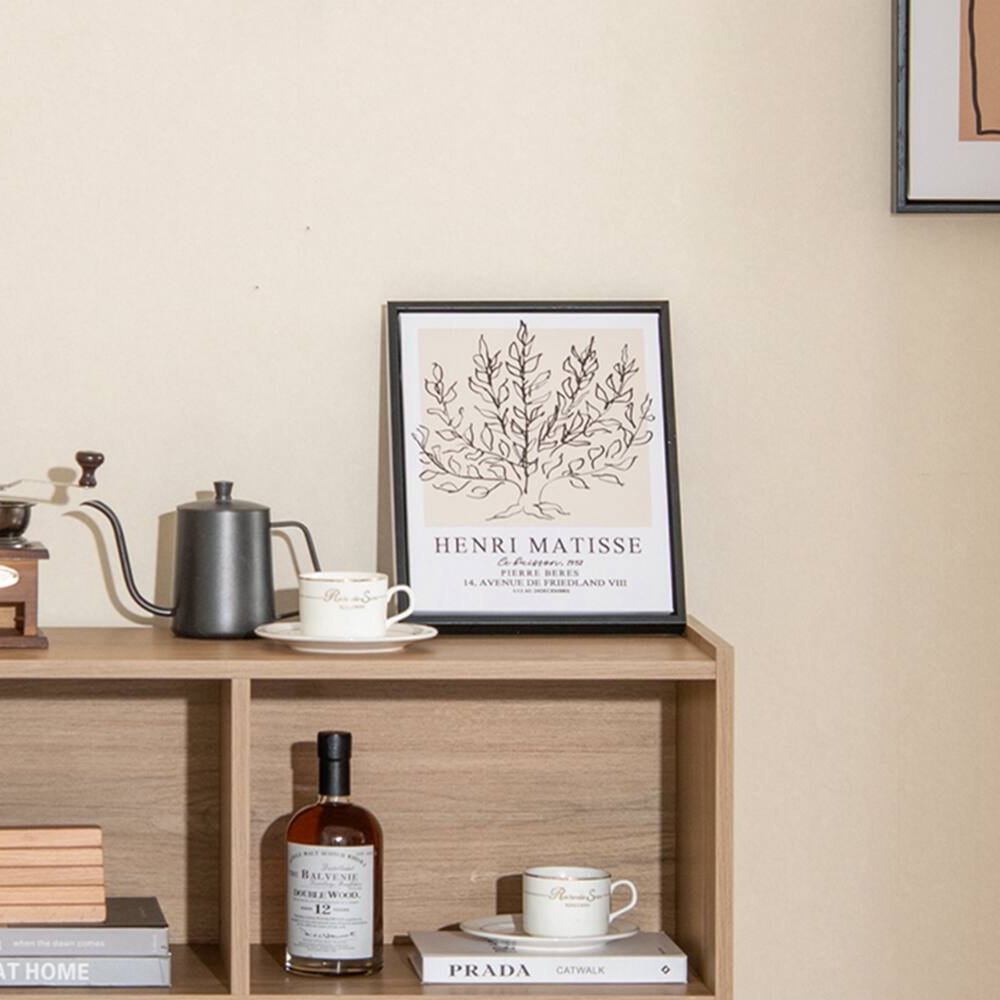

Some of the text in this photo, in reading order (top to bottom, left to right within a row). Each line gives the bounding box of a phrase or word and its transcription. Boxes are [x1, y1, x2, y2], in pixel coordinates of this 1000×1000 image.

[434, 537, 643, 554] HENRI MATISSE
[501, 569, 539, 577] PIERRE
[464, 579, 477, 588] 14,
[480, 579, 524, 587] AVENUE
[526, 579, 541, 587] DE
[543, 579, 606, 587] FRIEDLAND
[315, 904, 331, 915] 12
[36, 939, 50, 947] the
[26, 962, 90, 981] HOME
[449, 964, 606, 977] PRADA CATWALK
